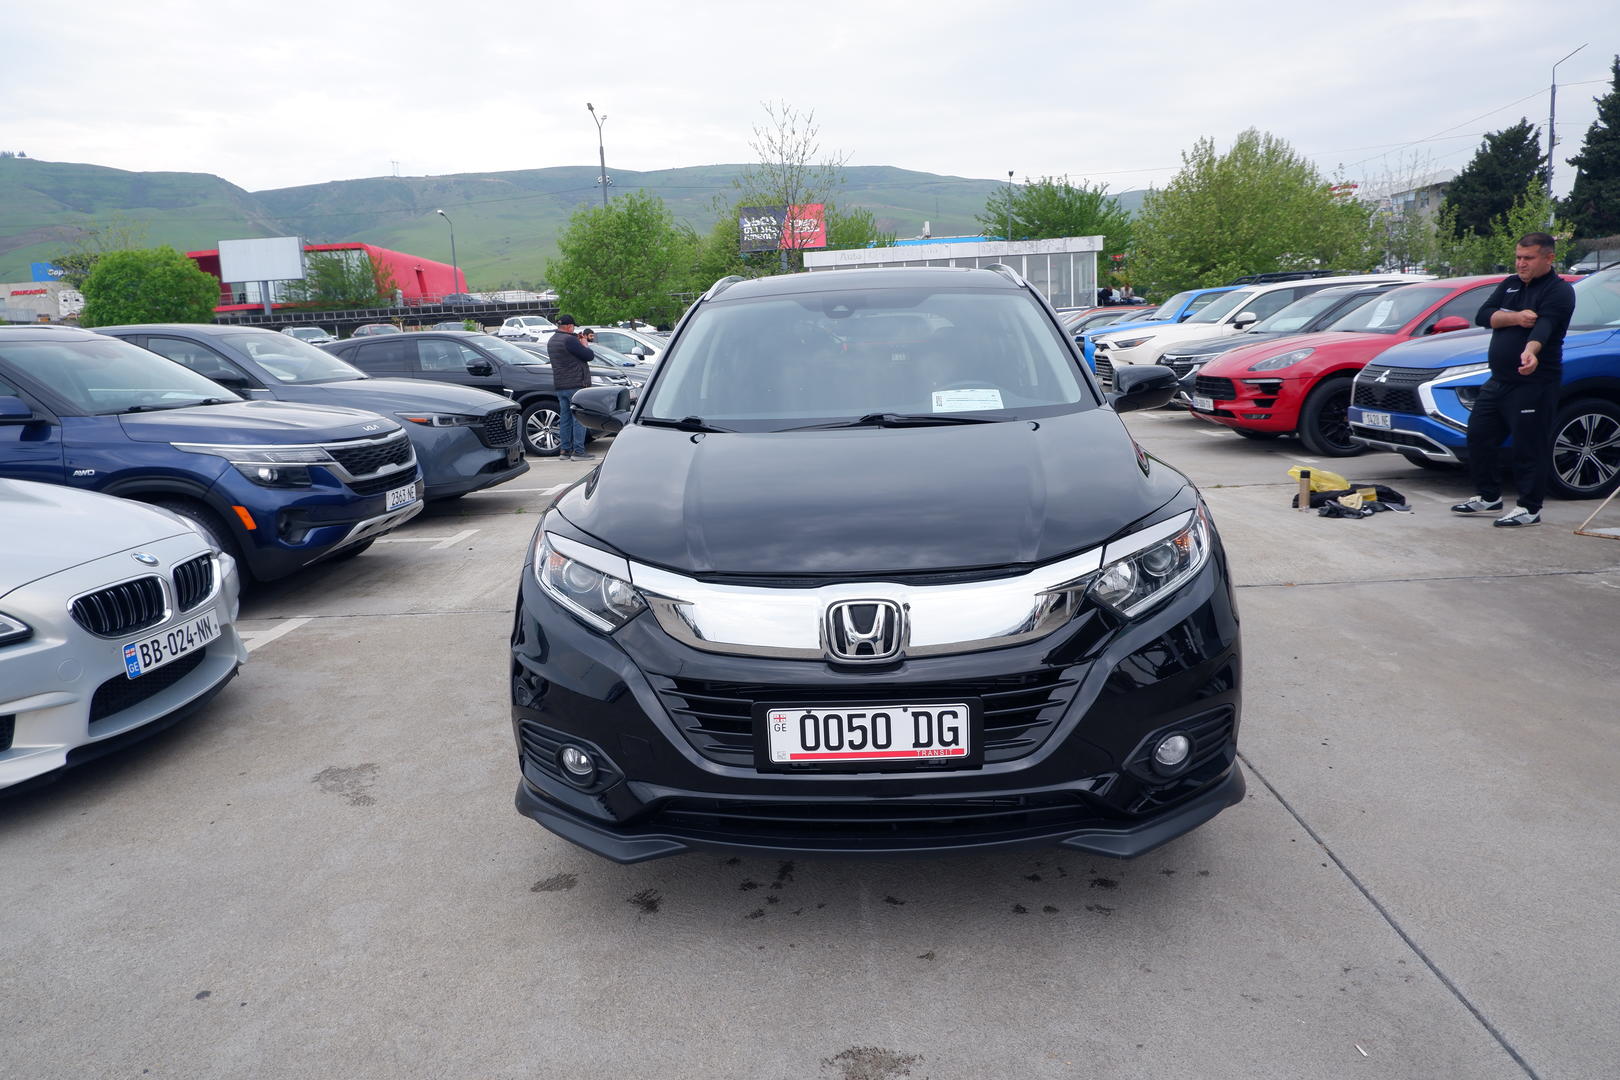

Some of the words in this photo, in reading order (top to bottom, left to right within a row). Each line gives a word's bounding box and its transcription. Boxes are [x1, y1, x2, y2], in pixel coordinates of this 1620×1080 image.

[72, 469, 96, 477] AWD
[139, 616, 213, 669] BB-024-NN
[128, 661, 140, 674] GE
[774, 723, 787, 732] GE
[799, 712, 892, 751] 0050
[911, 710, 960, 748] DG
[916, 749, 953, 757] TRANSIT
